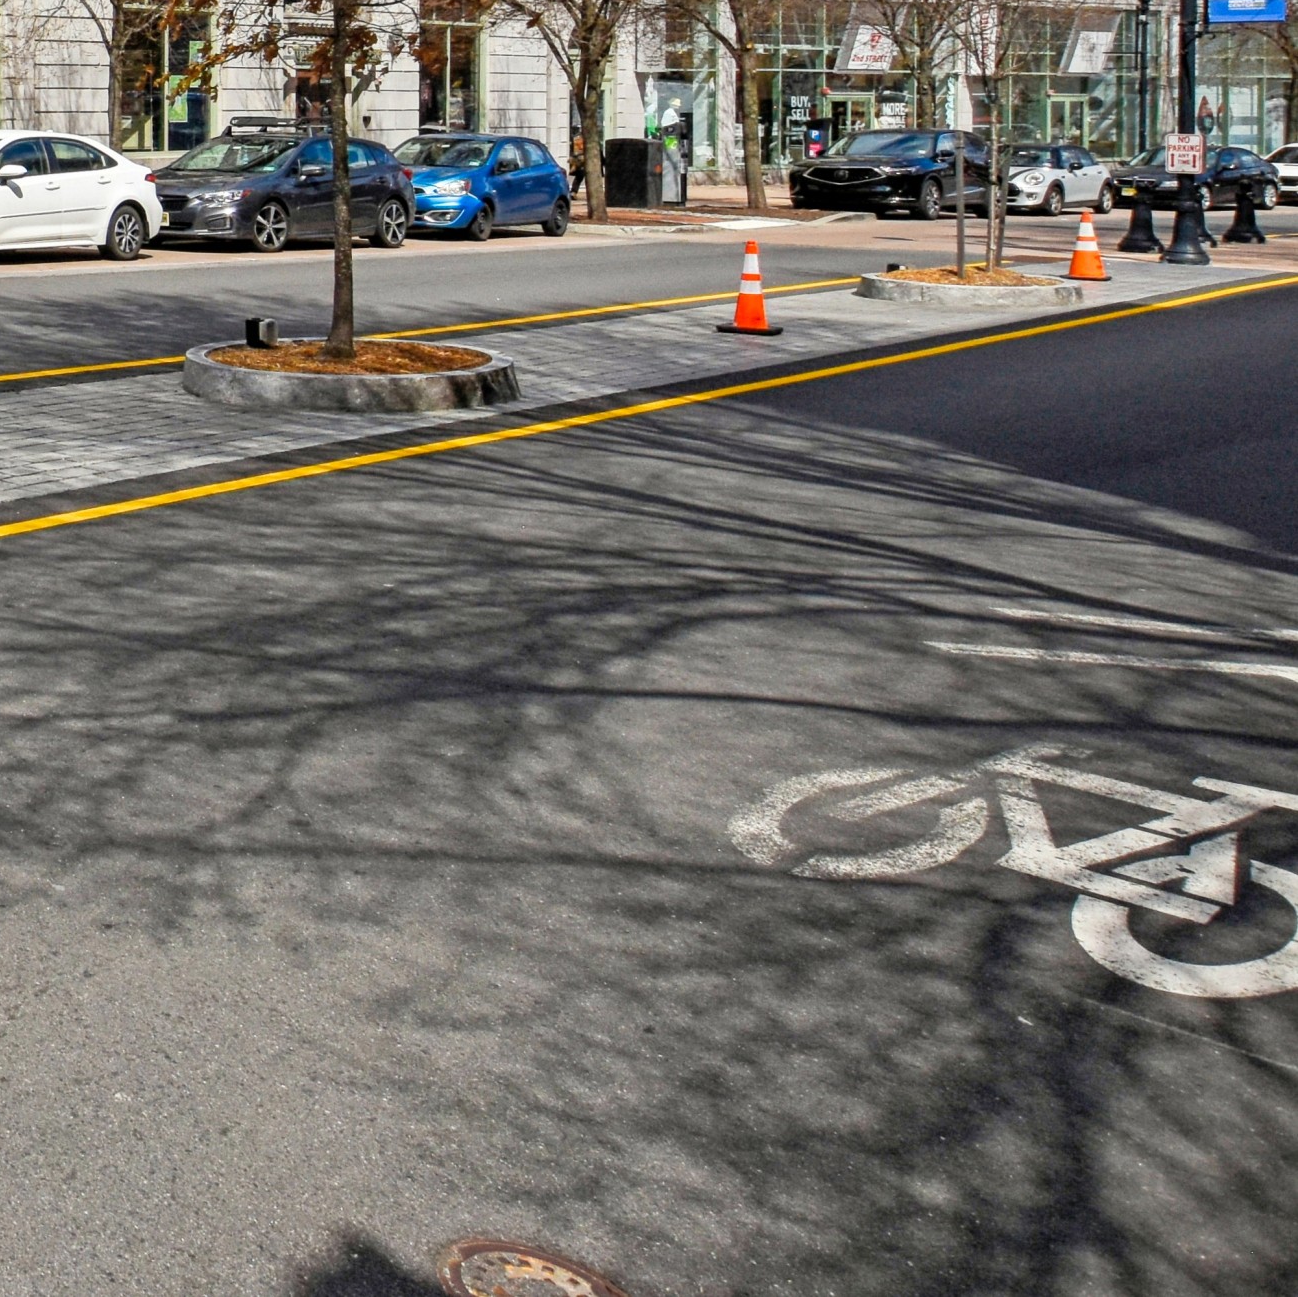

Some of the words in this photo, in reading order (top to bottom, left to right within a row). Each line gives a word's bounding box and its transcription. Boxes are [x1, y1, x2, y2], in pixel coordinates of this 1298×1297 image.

[851, 54, 863, 63] 2nd
[865, 54, 889, 63] STREET
[791, 109, 810, 120] SELL
[1168, 144, 1201, 152] PARKING
